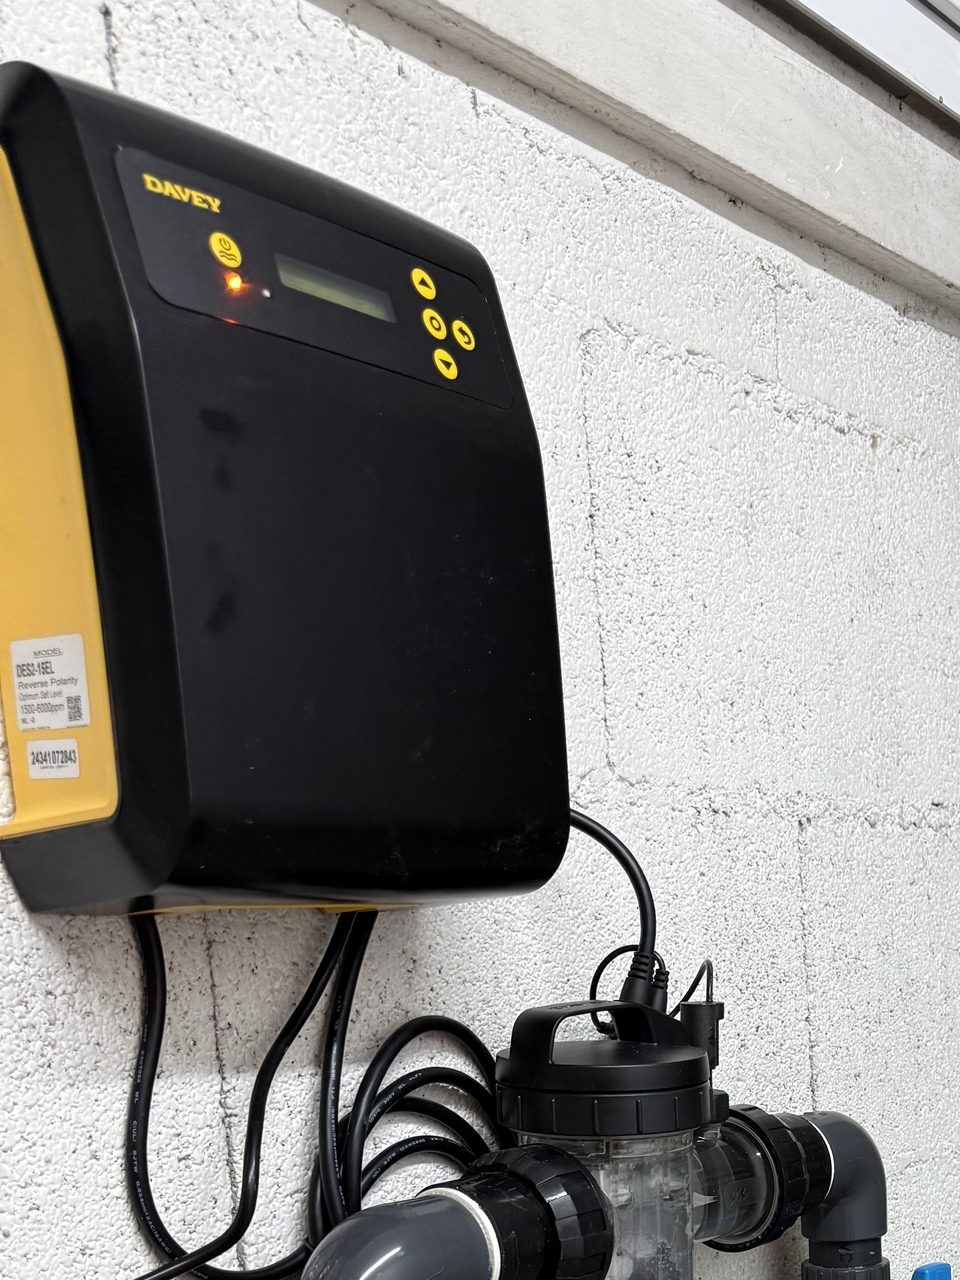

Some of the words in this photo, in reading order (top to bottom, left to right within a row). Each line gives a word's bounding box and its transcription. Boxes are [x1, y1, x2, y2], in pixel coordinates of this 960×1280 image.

[143, 173, 222, 213] DAVEY
[33, 648, 63, 657] MODEL
[16, 661, 55, 678] DES2-15EL
[18, 680, 48, 689] Reverse
[50, 677, 78, 687] Polarity
